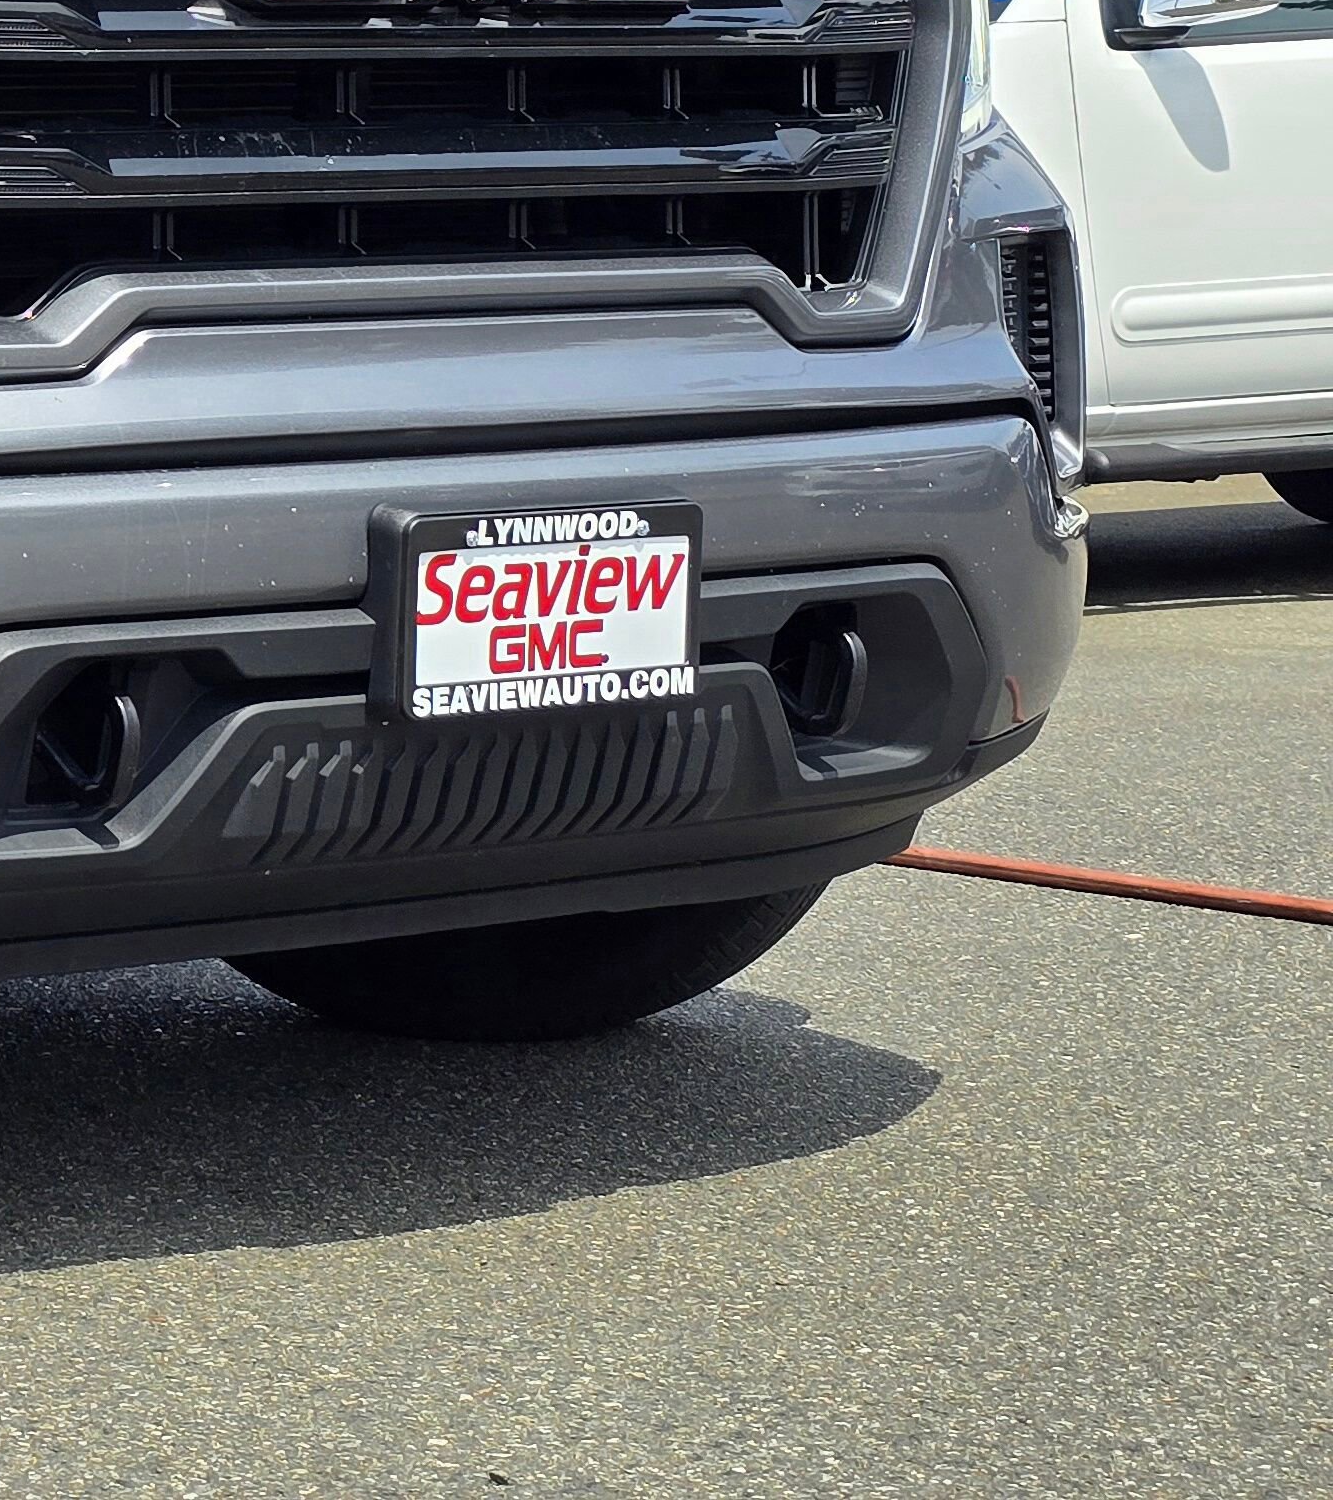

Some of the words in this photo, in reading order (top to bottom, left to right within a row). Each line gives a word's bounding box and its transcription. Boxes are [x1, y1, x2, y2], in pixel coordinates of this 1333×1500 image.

[478, 511, 639, 547] LYNNWOOD
[416, 544, 686, 625] Seaview
[489, 619, 606, 674] GMC
[413, 666, 695, 718] SEAVIEWAUTO.COM
